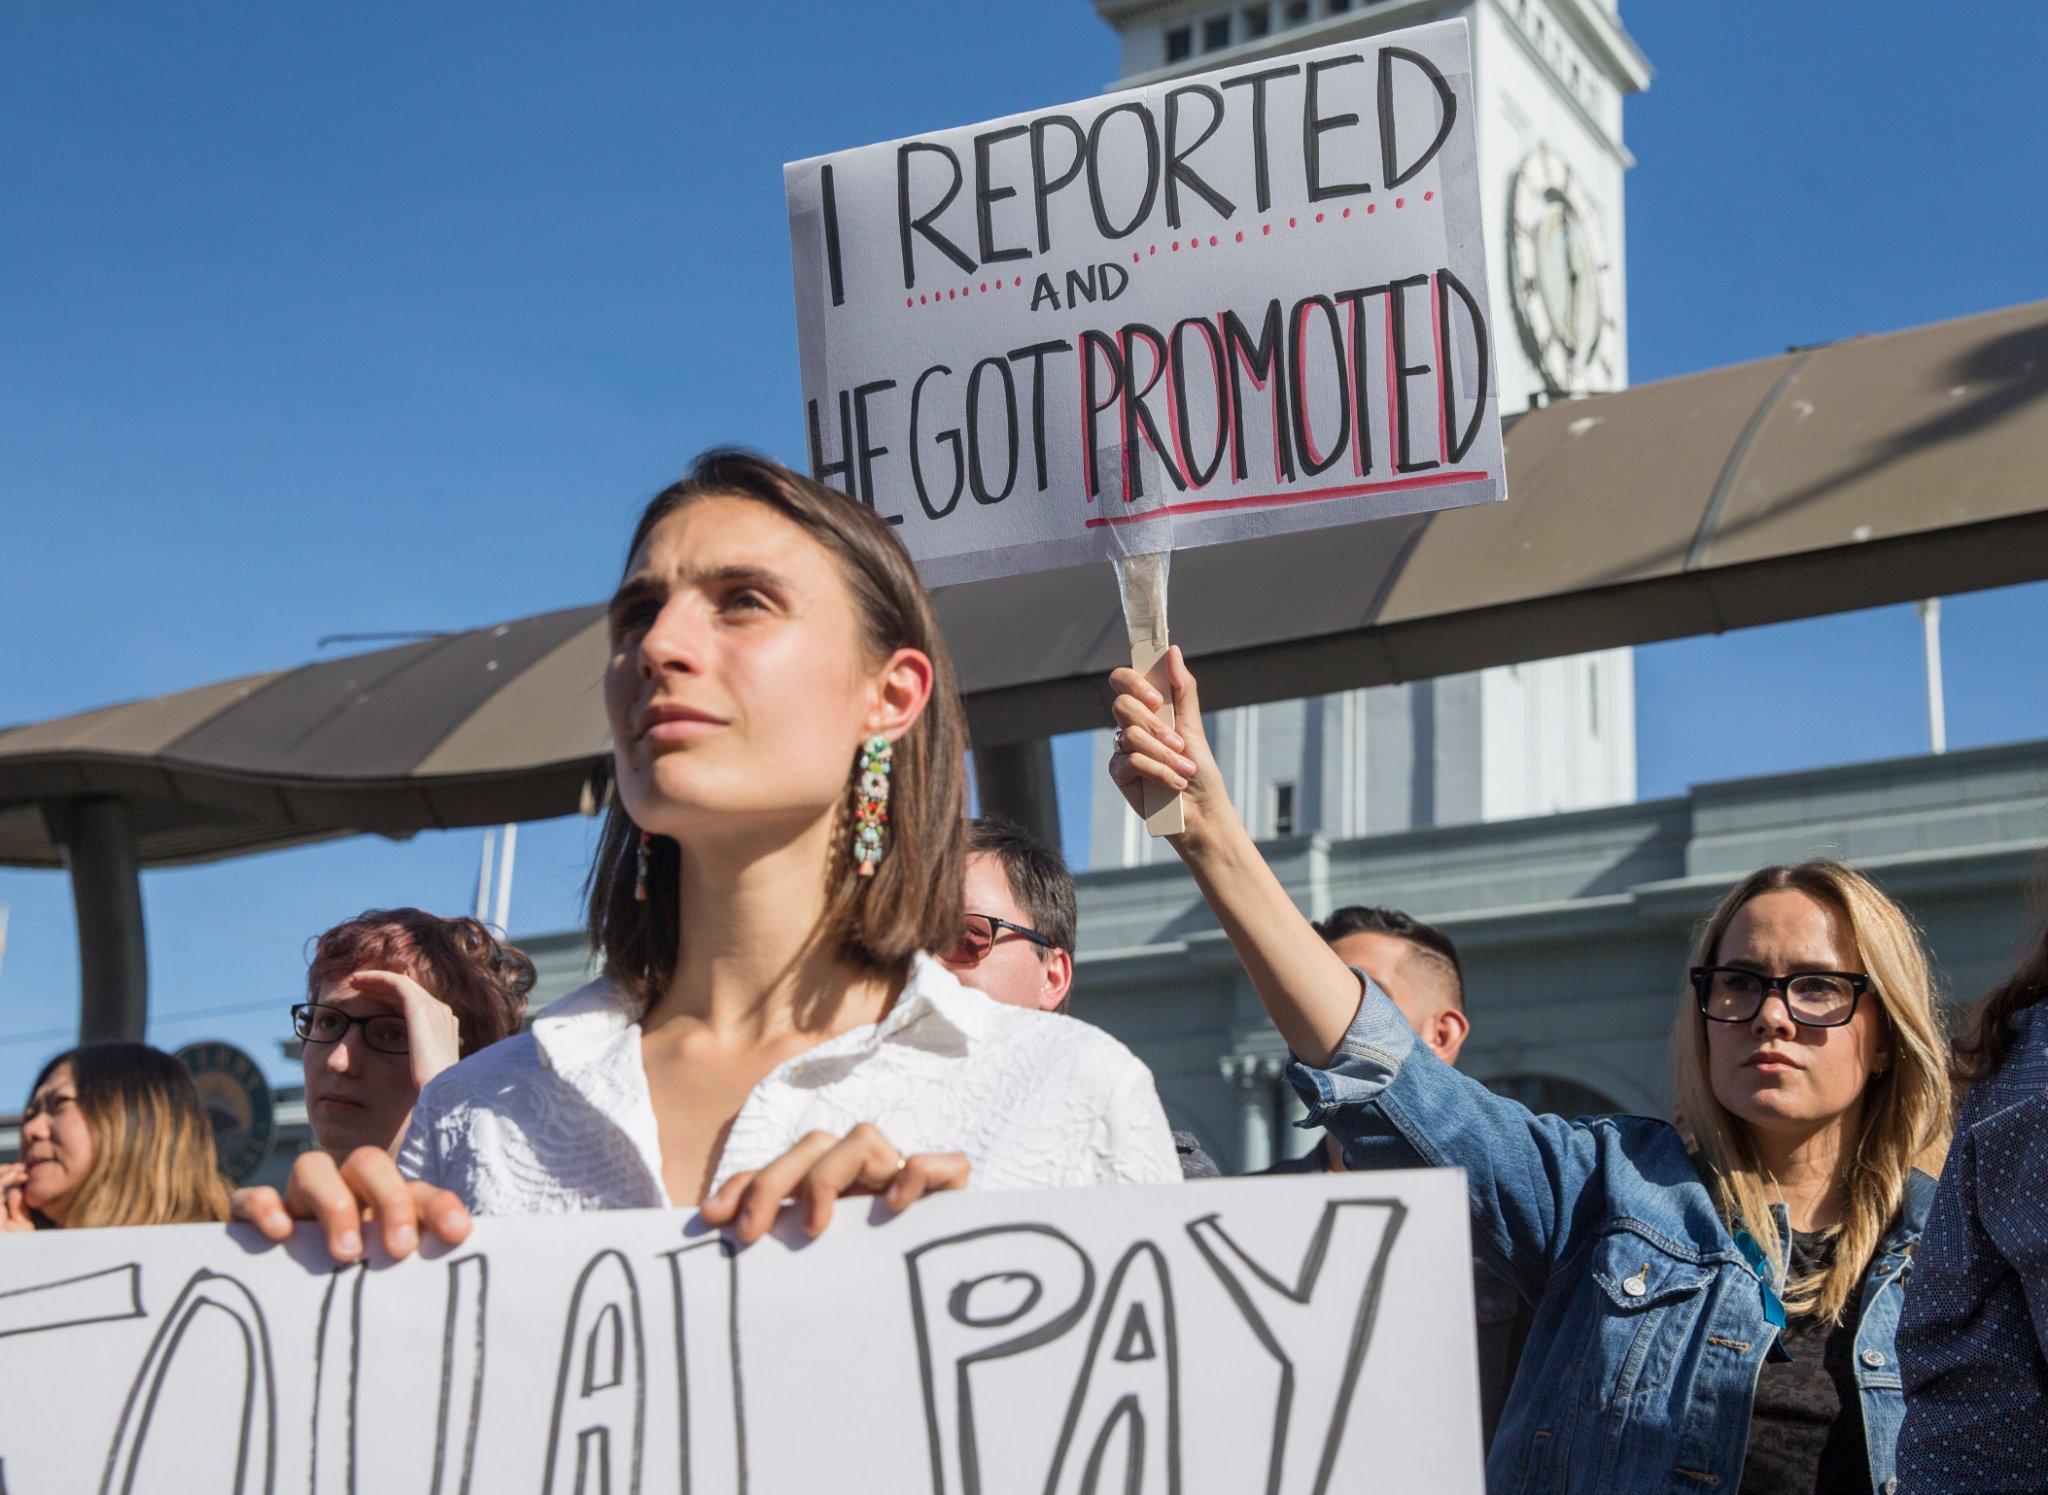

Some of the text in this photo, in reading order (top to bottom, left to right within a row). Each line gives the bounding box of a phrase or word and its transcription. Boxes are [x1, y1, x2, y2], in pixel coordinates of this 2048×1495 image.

[821, 46, 1457, 307] I REPORTED
[1030, 262, 1130, 312] AND
[807, 268, 1488, 525] HE GOT PROMOTED
[904, 1197, 1408, 1495] PAY
